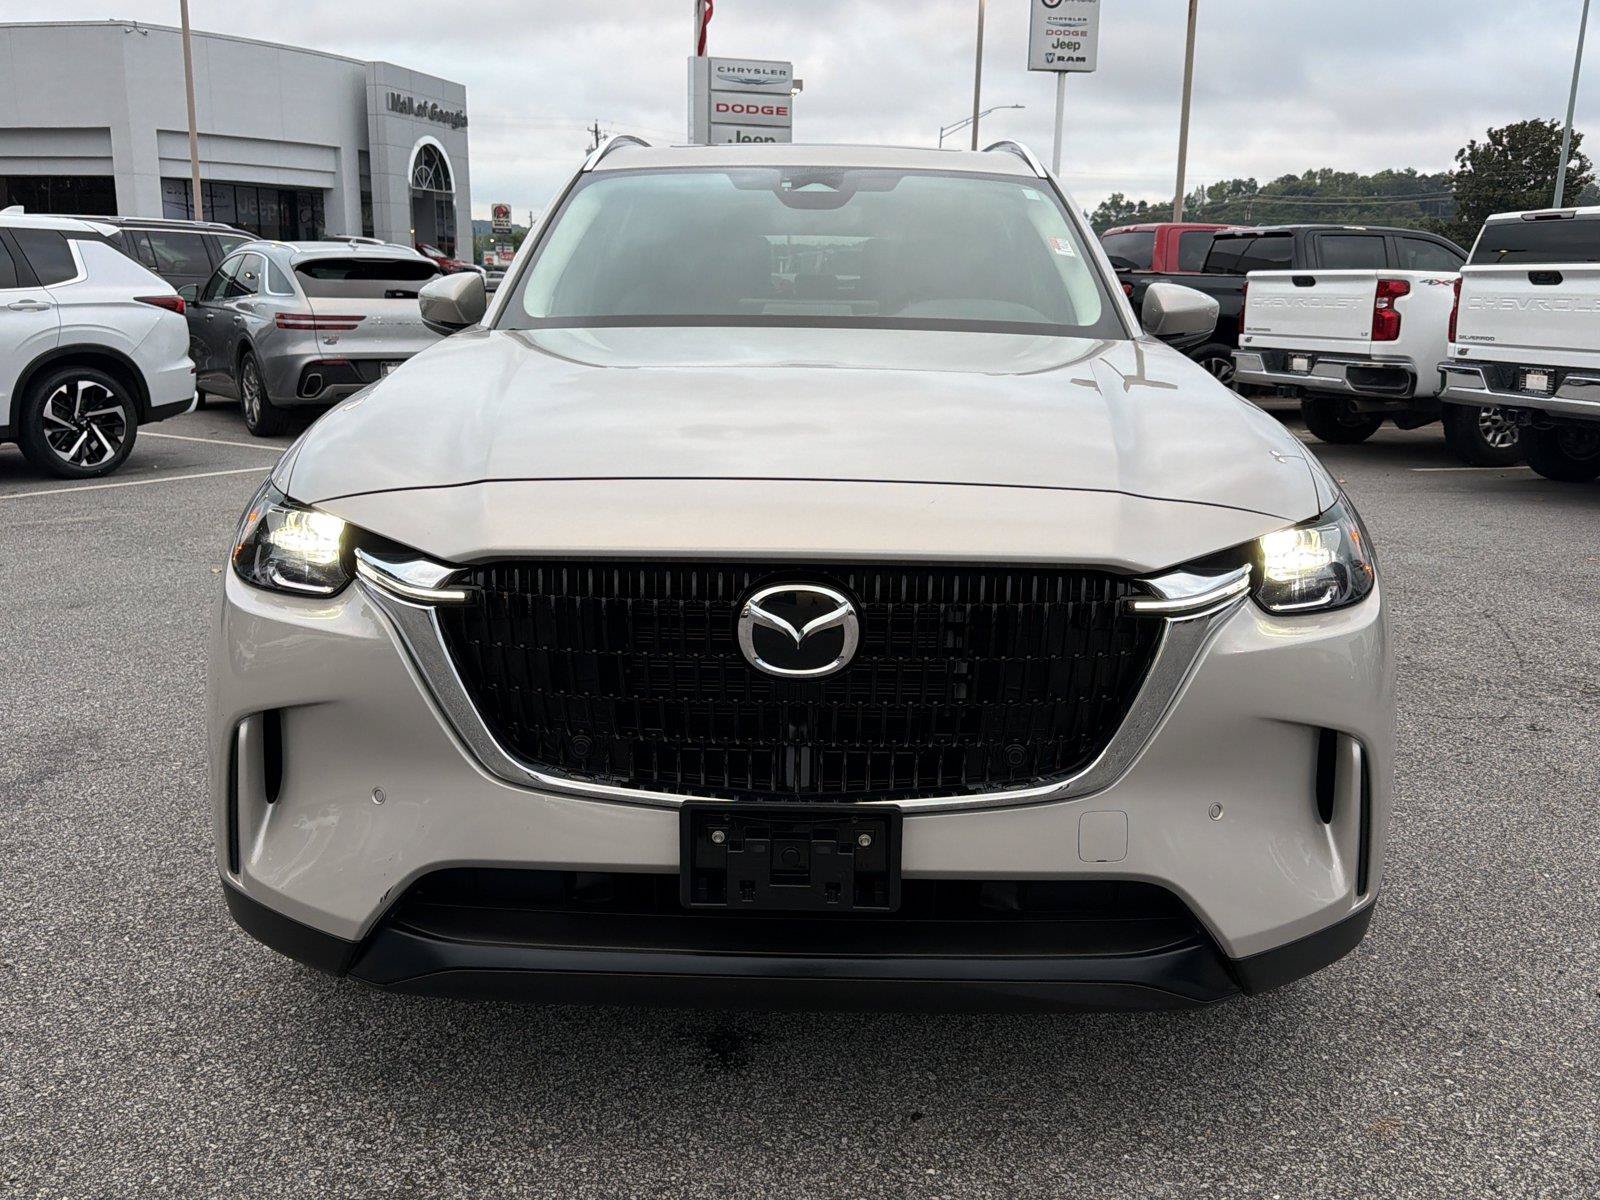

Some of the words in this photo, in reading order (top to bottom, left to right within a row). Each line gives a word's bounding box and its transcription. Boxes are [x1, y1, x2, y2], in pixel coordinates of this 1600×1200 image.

[1051, 38, 1081, 52] Jeep
[717, 66, 787, 76] CHRYSLER
[716, 103, 788, 116] DODGE
[1251, 297, 1363, 309] CHEVROLET
